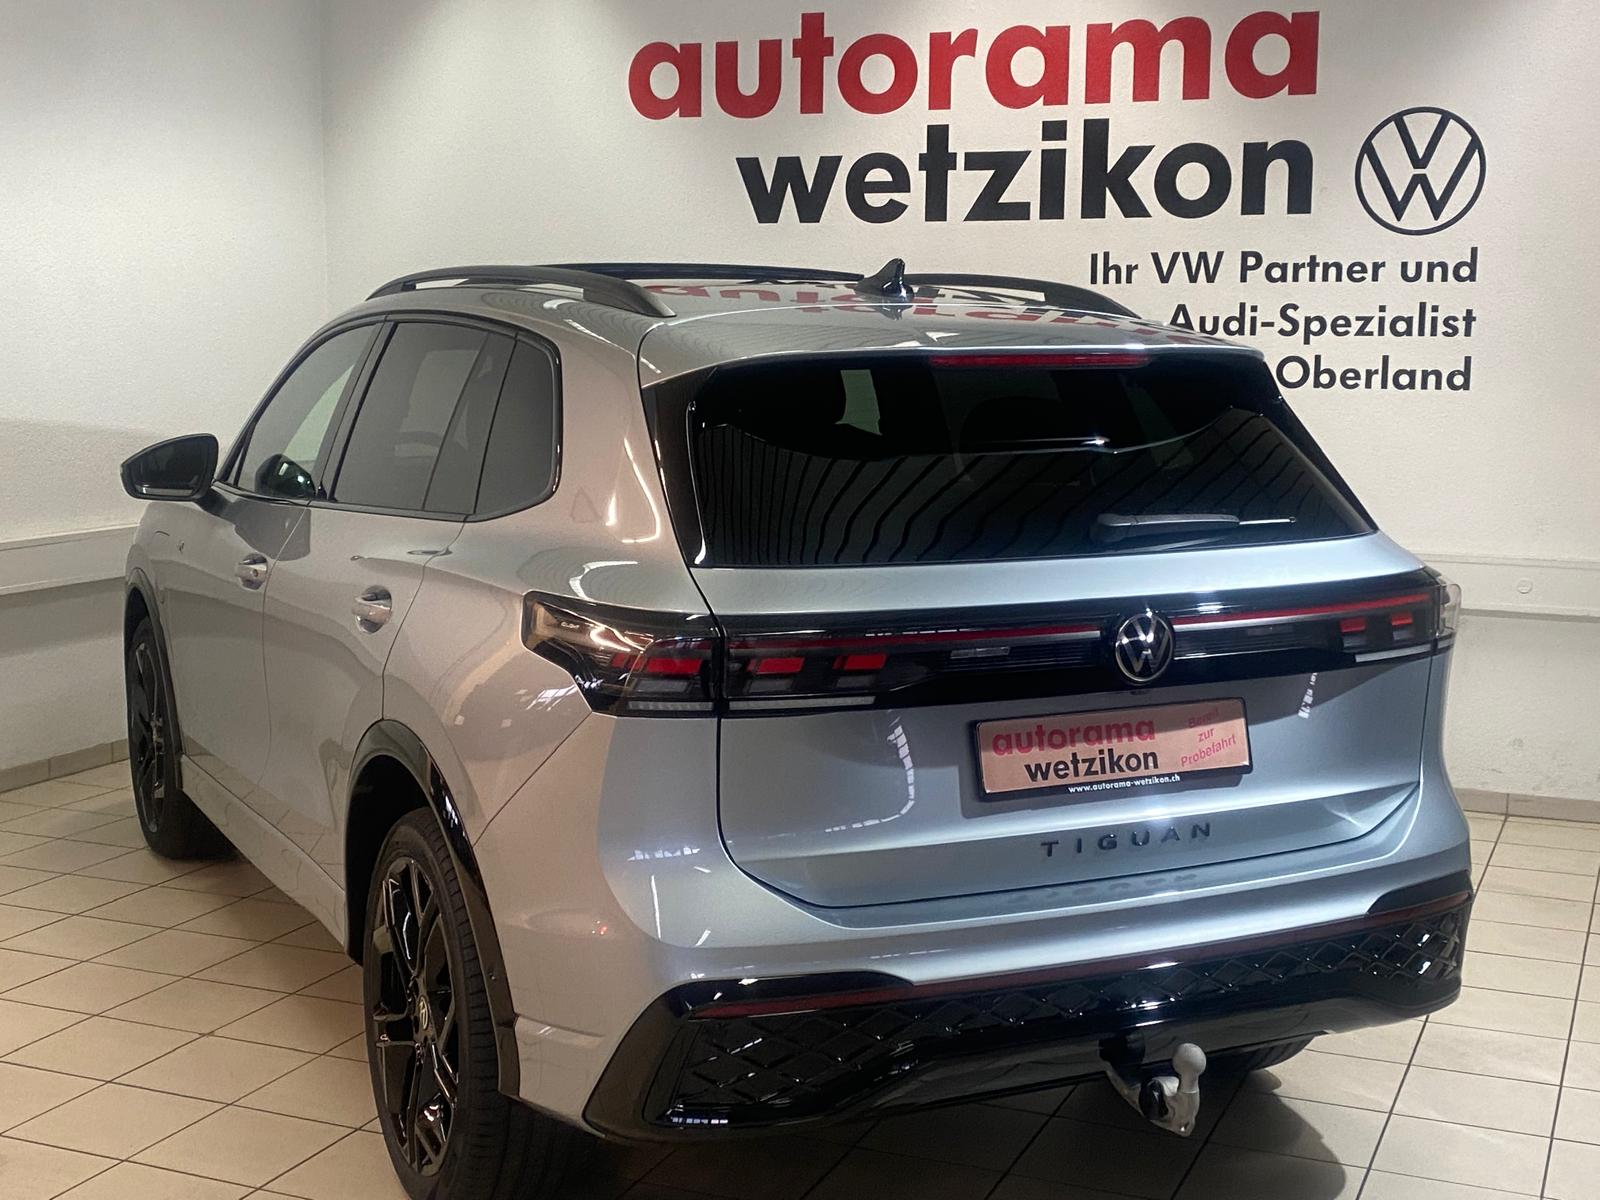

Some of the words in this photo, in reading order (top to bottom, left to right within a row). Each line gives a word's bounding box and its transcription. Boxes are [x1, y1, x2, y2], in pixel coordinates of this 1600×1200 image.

[629, 11, 1320, 119] autorama
[736, 118, 1312, 224] wetzikon
[1090, 252, 1138, 284] Ihr
[1151, 251, 1224, 284] VW
[1240, 250, 1386, 283] Partner
[1400, 246, 1478, 282] und
[1169, 302, 1477, 345] Audi-Spezialist
[1276, 354, 1472, 391] Oberland
[991, 718, 1156, 756] autorama
[1180, 733, 1237, 768] Probefahrt
[1197, 727, 1216, 743] zur
[1024, 748, 1159, 782] wetzikon
[1067, 773, 1181, 794] www.autorama-wetzikon.ch
[1040, 822, 1212, 858] TIGUAN
